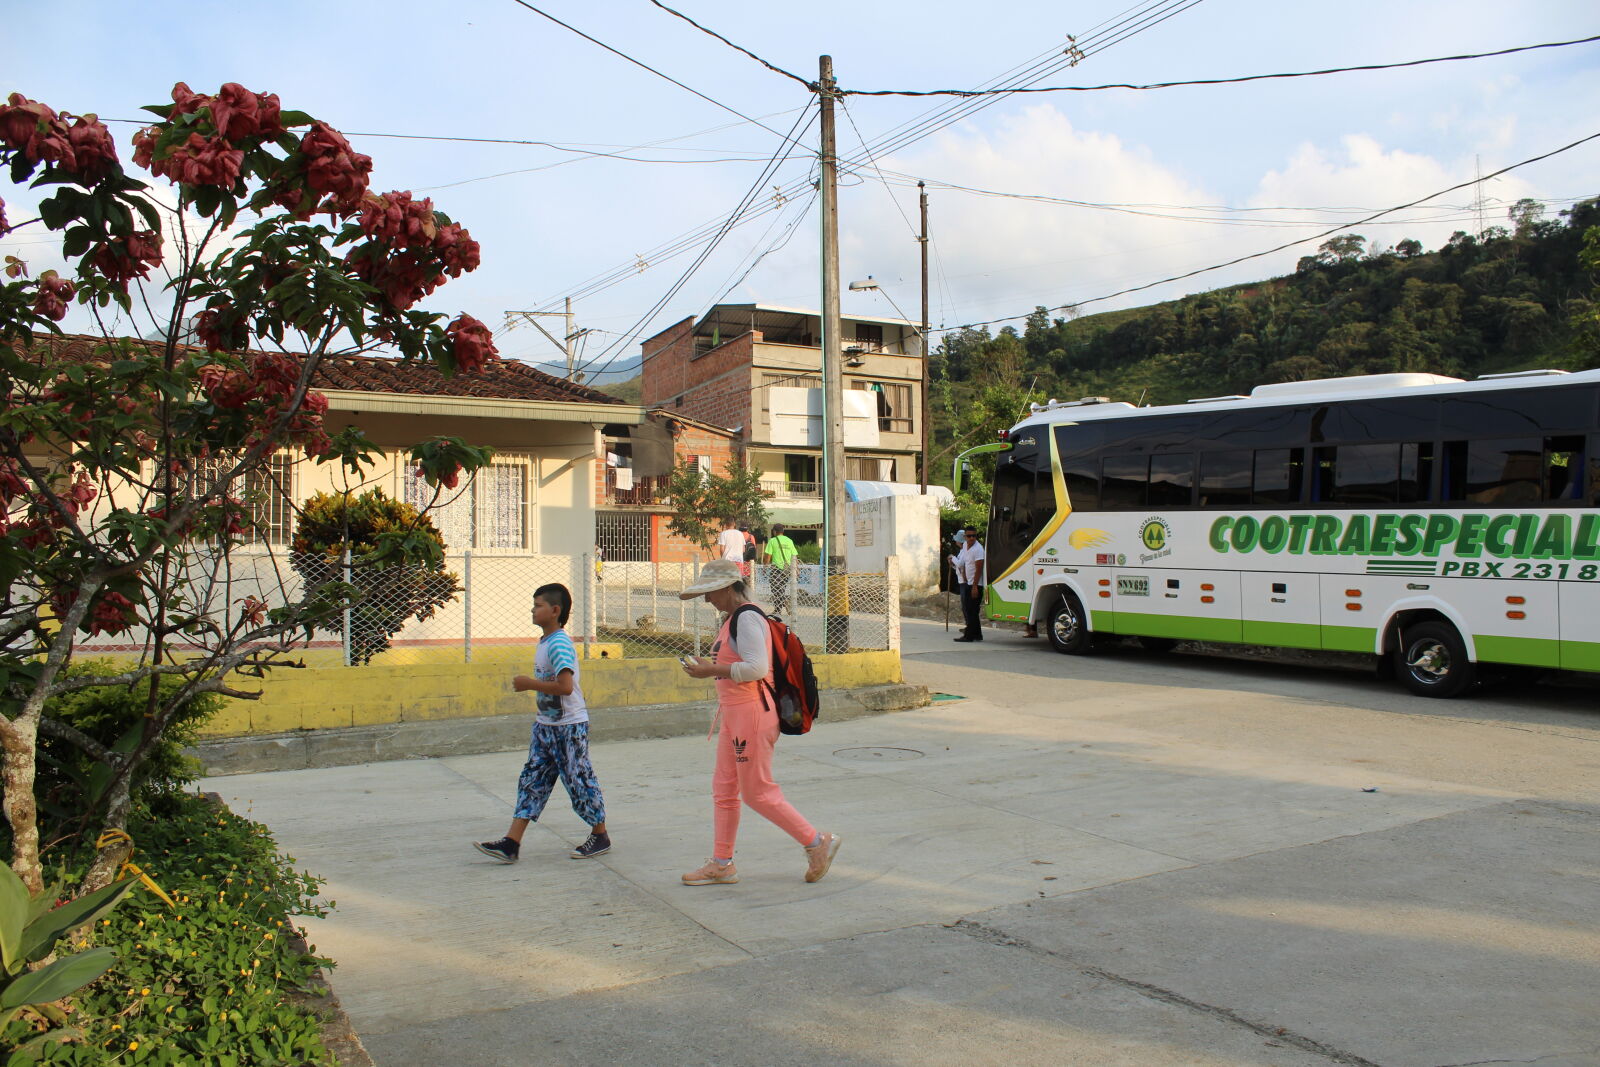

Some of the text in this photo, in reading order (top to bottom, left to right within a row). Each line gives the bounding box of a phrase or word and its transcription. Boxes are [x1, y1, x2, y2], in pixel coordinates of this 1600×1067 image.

[1209, 513, 1600, 561] COOTRAESPECIAL
[1441, 560, 1505, 578] PBX
[1008, 579, 1027, 591] 398
